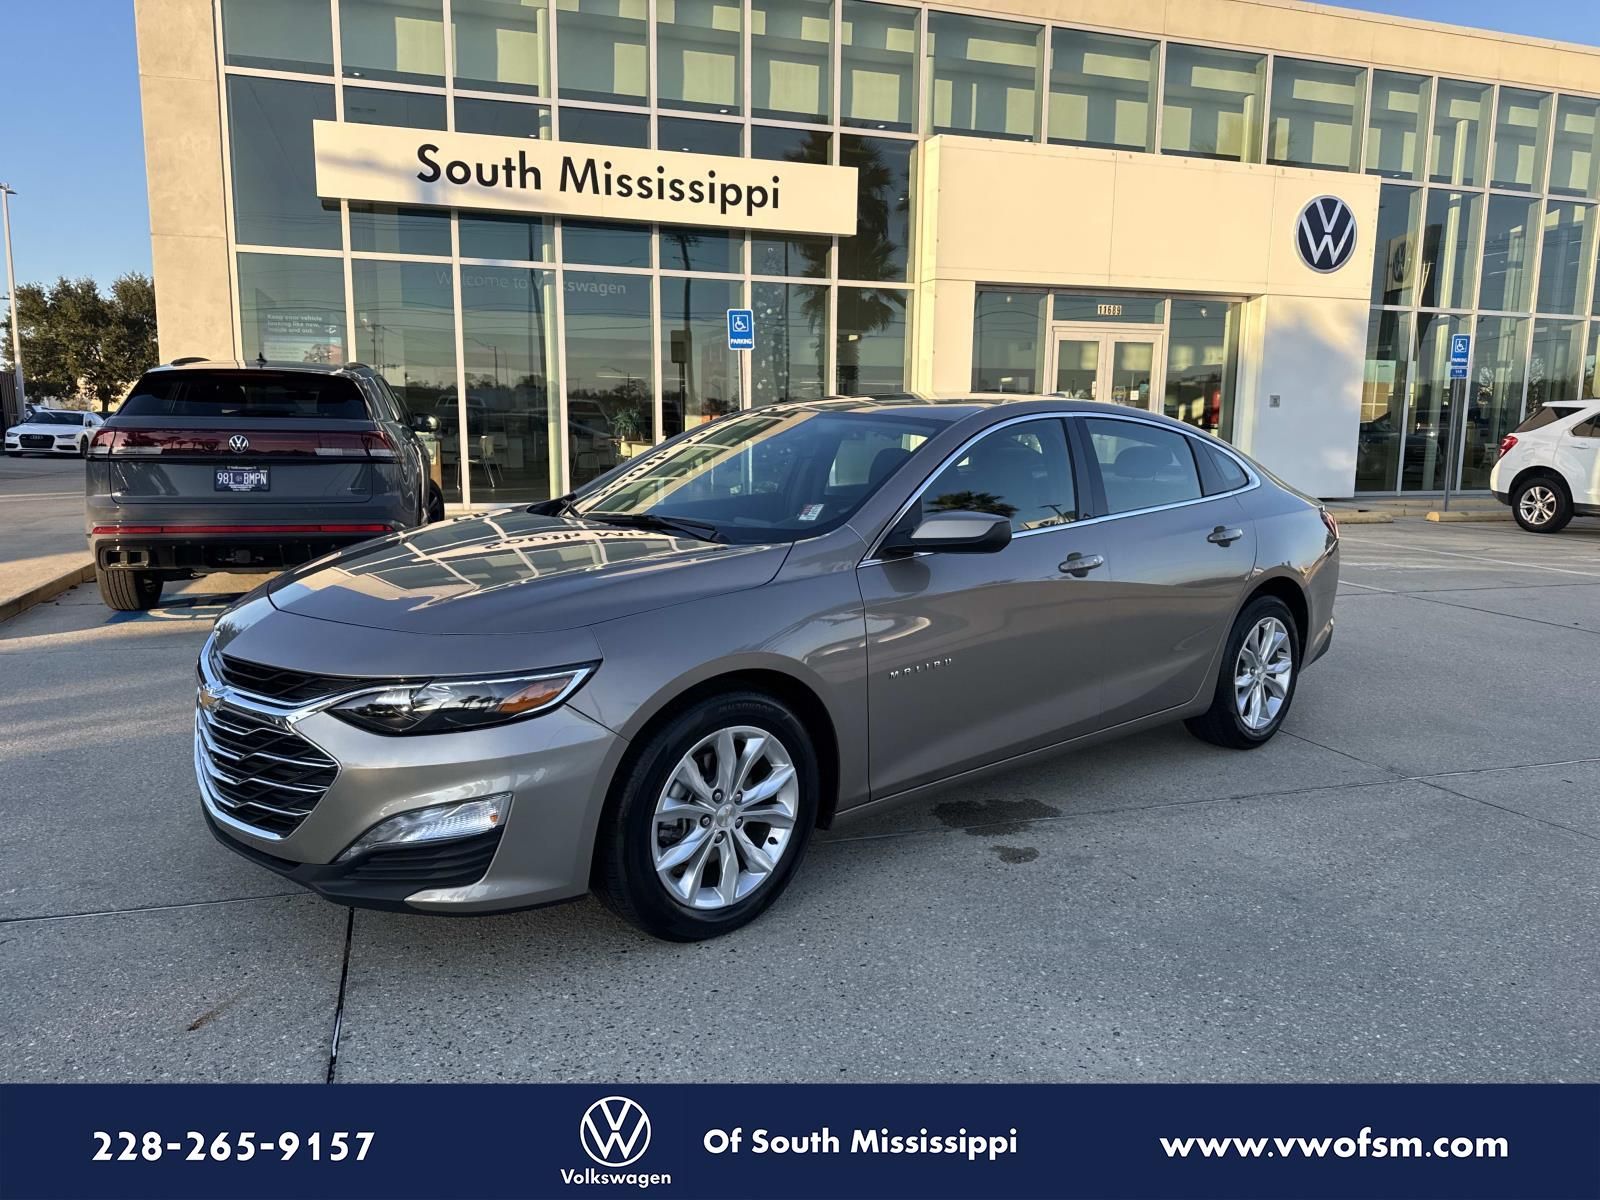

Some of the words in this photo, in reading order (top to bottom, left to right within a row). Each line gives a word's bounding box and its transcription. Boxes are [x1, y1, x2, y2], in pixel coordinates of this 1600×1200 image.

[417, 143, 541, 190] South
[560, 156, 779, 216] Mississippi
[435, 270, 508, 289] Wlcome
[513, 276, 529, 290] to
[535, 279, 627, 296] Vswagen
[217, 472, 234, 484] 981
[889, 658, 952, 680] MALIBU
